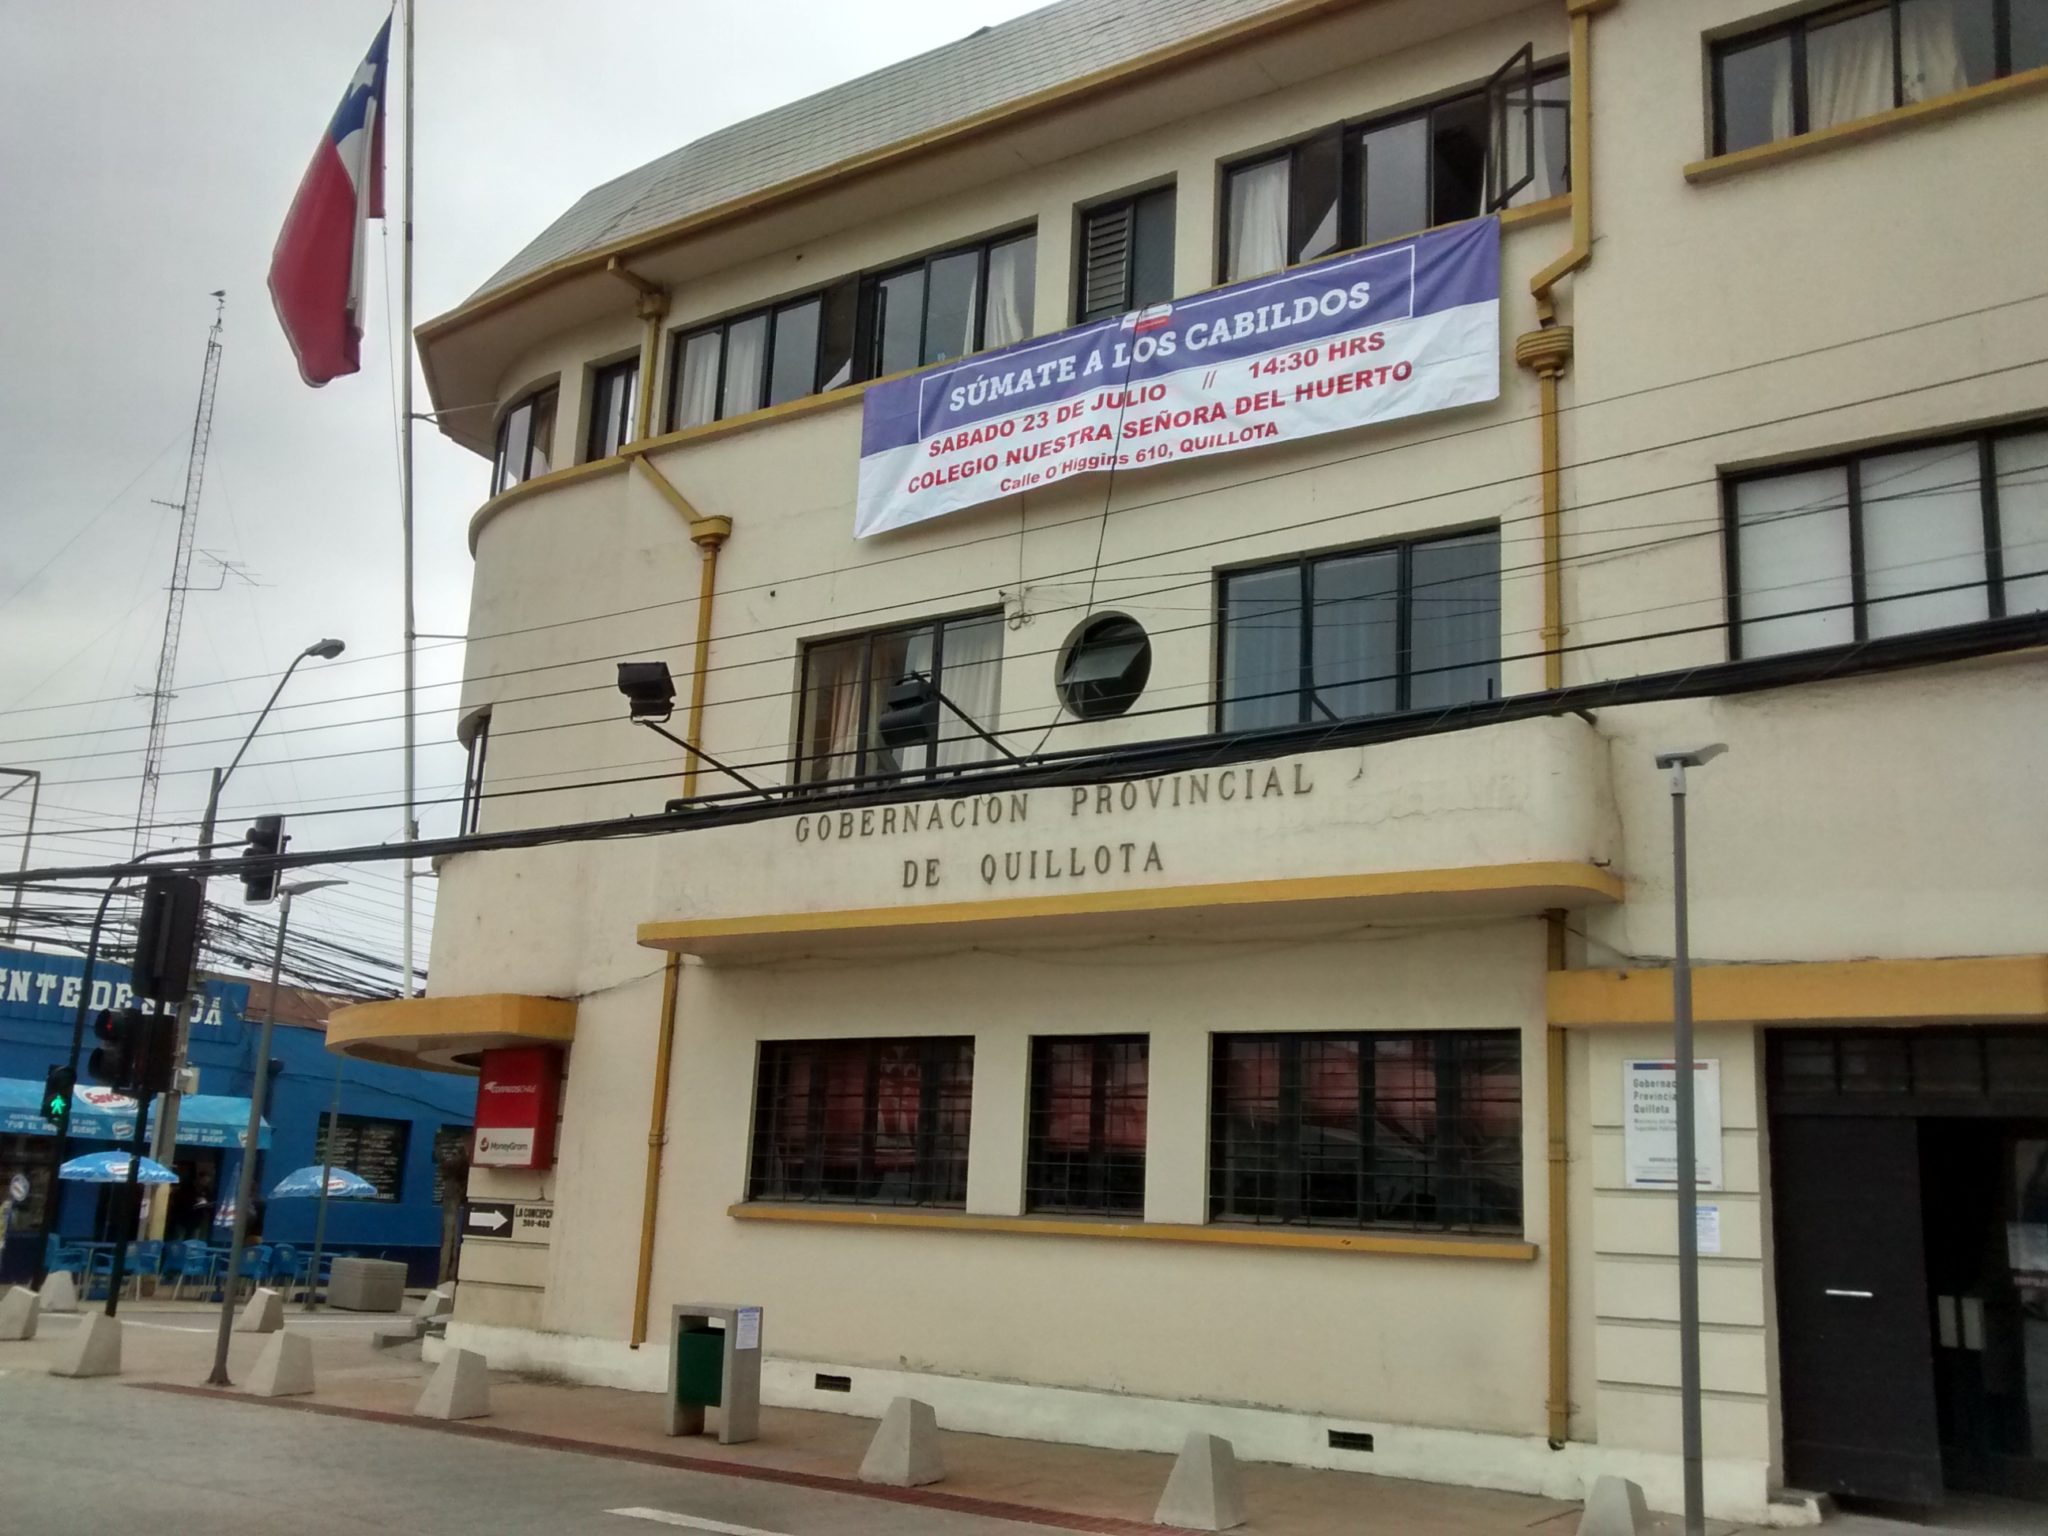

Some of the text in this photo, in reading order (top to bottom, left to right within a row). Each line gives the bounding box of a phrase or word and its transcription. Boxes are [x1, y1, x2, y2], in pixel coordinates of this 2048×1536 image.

[950, 355, 1076, 411] SÚMATE
[1082, 350, 1104, 376] A
[1112, 331, 1177, 368] LOS
[1185, 282, 1371, 351] CABILDOS
[928, 420, 1015, 457] SABADO
[1022, 411, 1049, 433] 23
[1056, 400, 1085, 424] DE
[1091, 383, 1167, 411] JULIO
[1248, 349, 1318, 379] 14:30
[1328, 331, 1385, 361] HRS
[908, 360, 1413, 494] COLEGIO NUESTRA SEÑORA DEL HUERTO
[1000, 472, 1040, 492] Calle
[1135, 443, 1174, 464] 610,
[1180, 422, 1279, 453] QUILLOTA
[1071, 763, 1315, 817] PROVINCIAL
[902, 842, 1164, 888] DE QUILLOTA
[0, 968, 83, 1008] NTE
[1633, 1091, 1677, 1101] Provincia
